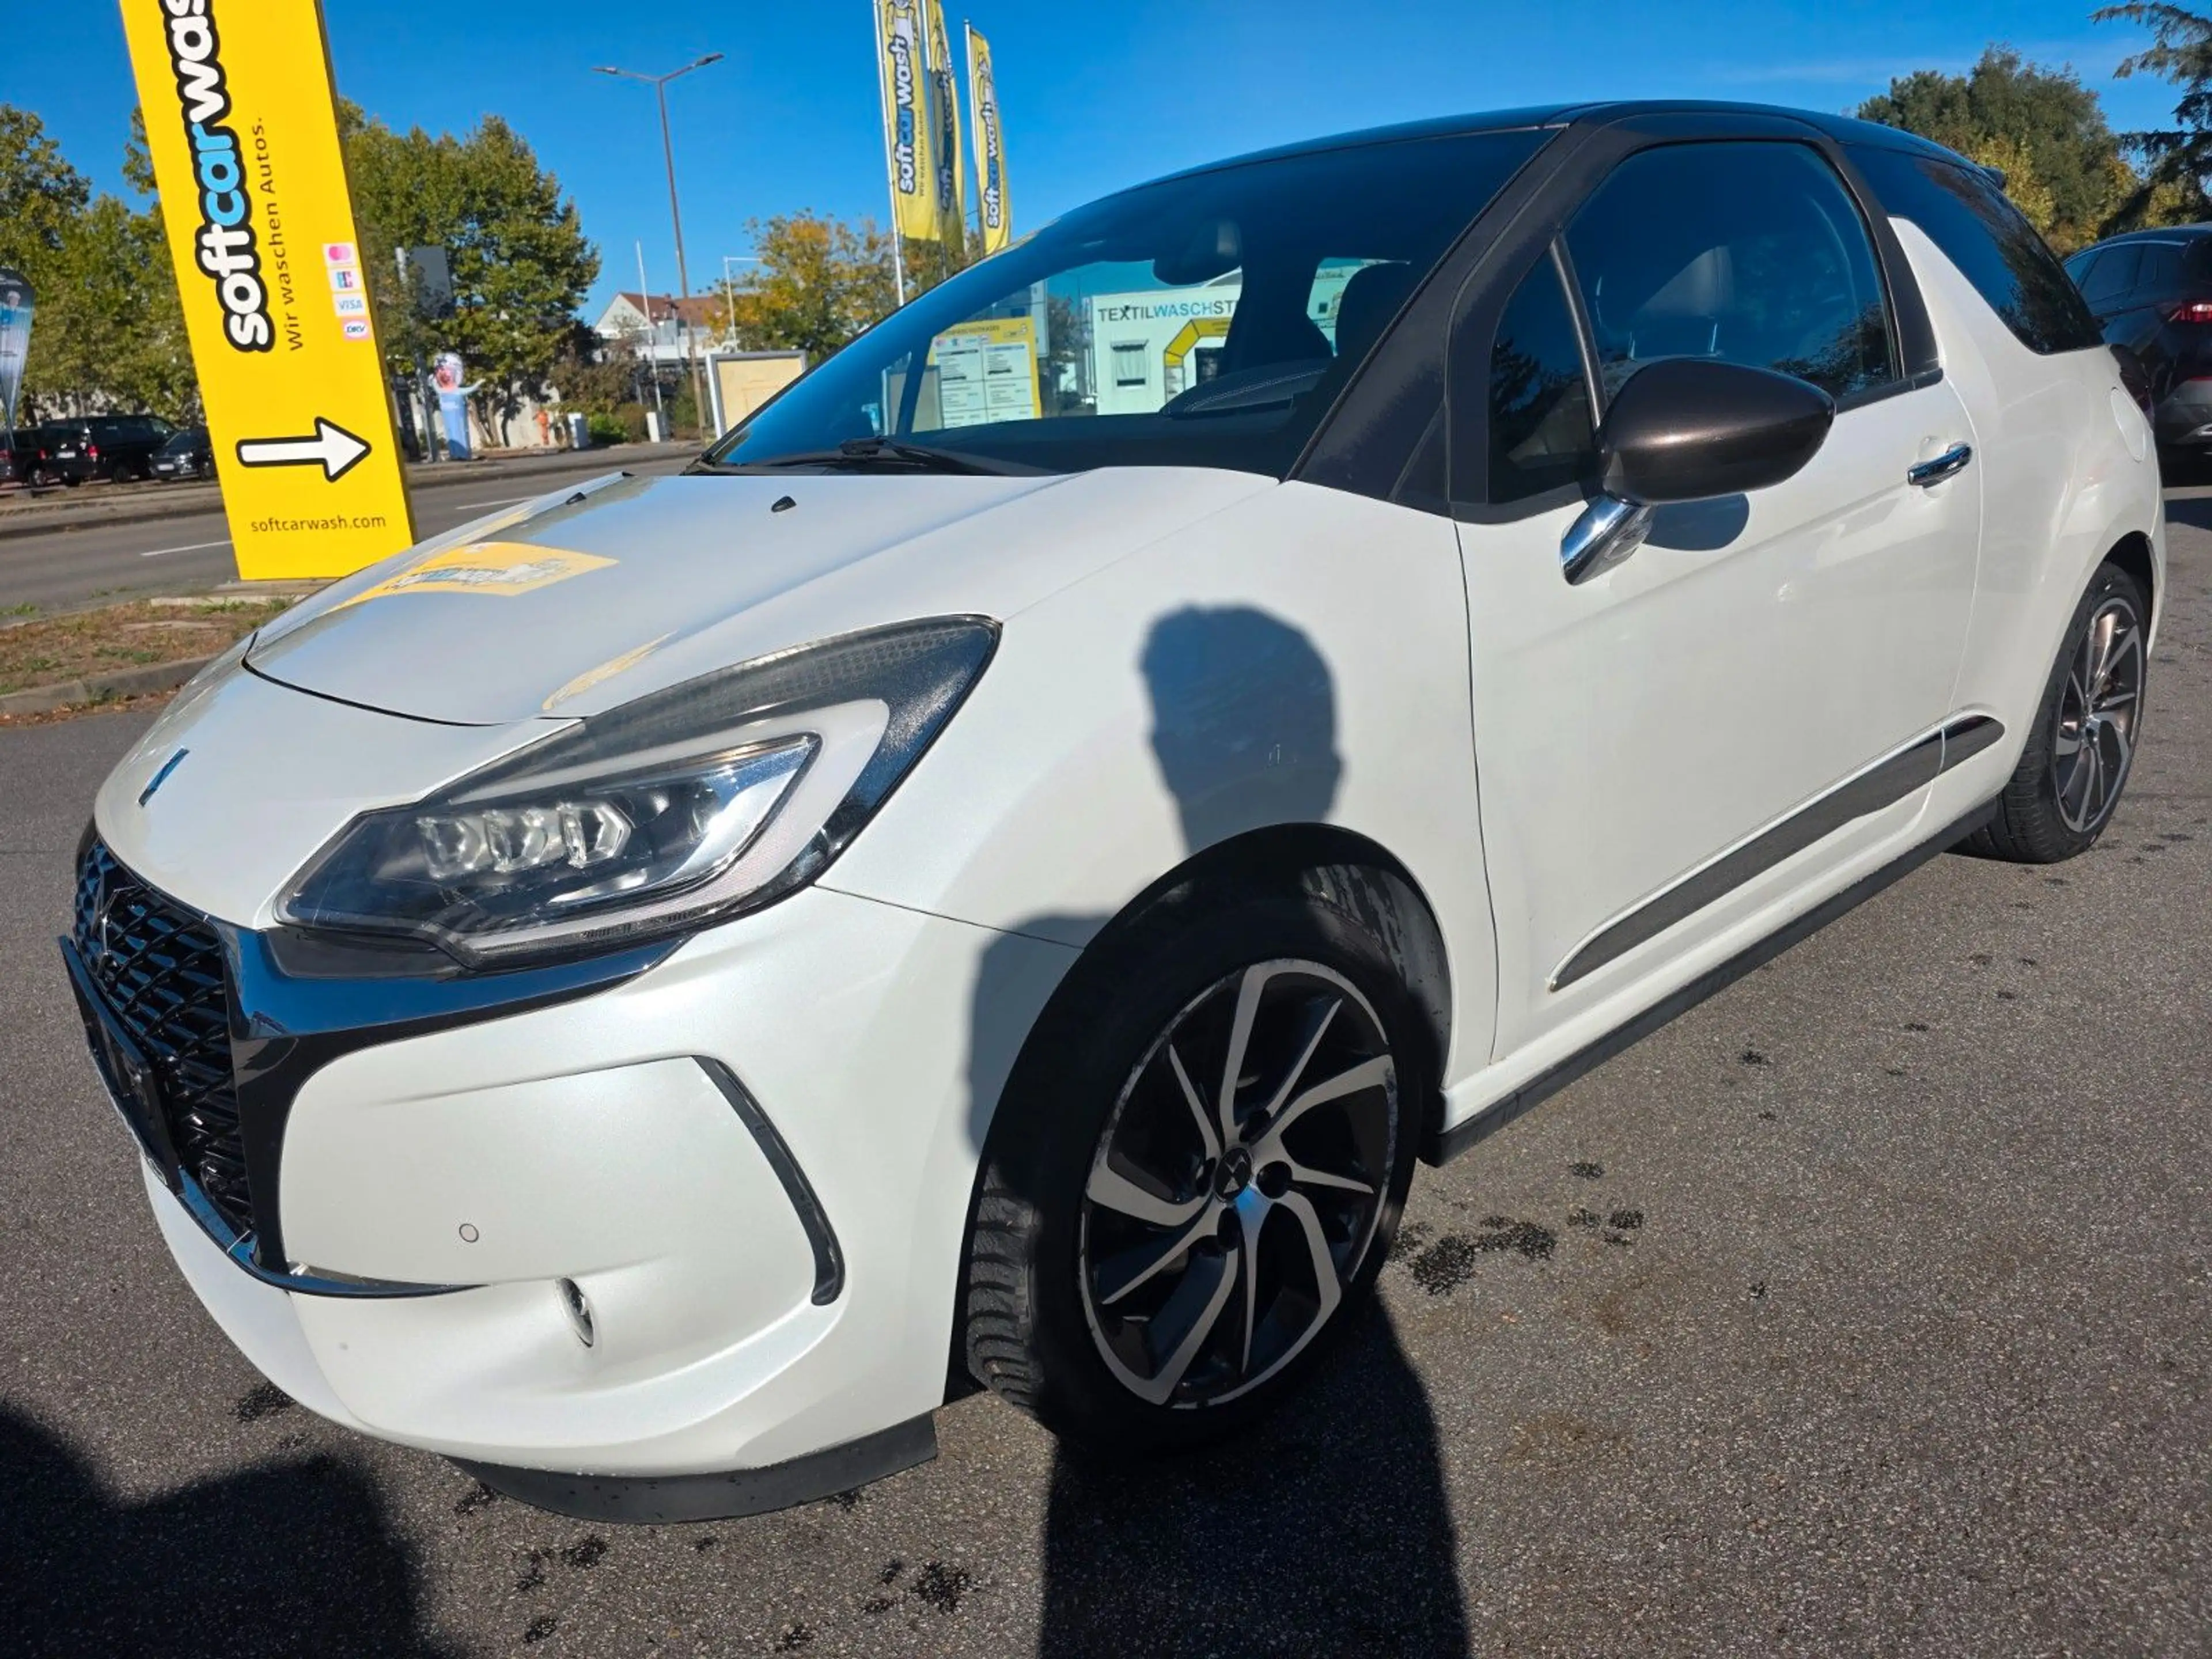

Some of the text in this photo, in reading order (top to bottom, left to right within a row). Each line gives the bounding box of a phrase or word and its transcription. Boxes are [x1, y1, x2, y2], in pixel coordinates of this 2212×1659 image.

[889, 36, 914, 194] softcarwash
[252, 117, 304, 351] Wir waschen Autos.
[338, 299, 363, 310] VISA
[251, 514, 387, 532] softcarwash.com
